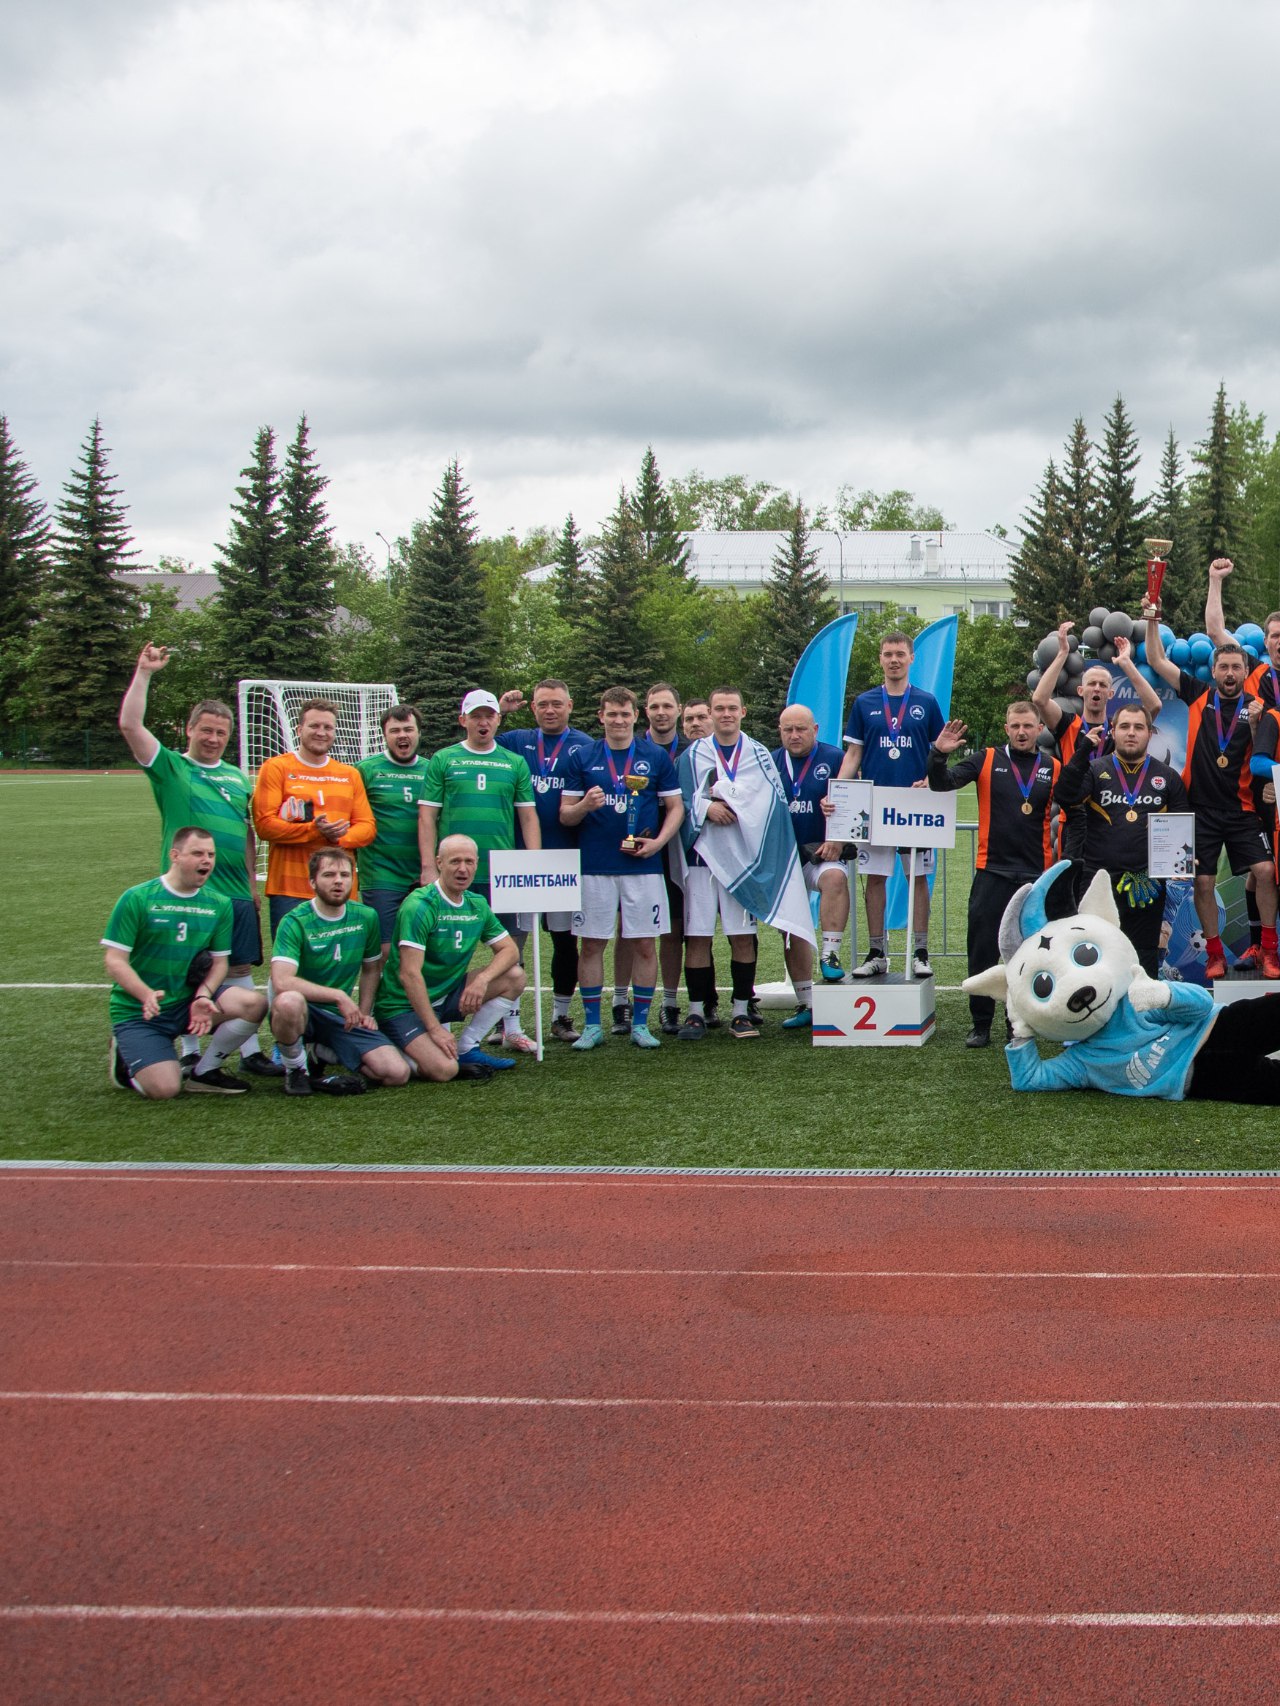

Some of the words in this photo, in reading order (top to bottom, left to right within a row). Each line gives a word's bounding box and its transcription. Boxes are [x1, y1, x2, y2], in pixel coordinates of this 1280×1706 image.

[461, 759, 513, 769] УГЛЕМЕТБАНК
[477, 773, 487, 791] 8
[317, 789, 325, 806] 1
[402, 786, 414, 803] 5
[882, 807, 945, 827] Нытва
[494, 873, 578, 889] УГЛЕМЕТБАНК
[175, 921, 188, 942] 3
[455, 930, 463, 949] 2
[333, 943, 343, 961] 4
[853, 996, 877, 1031] 2
